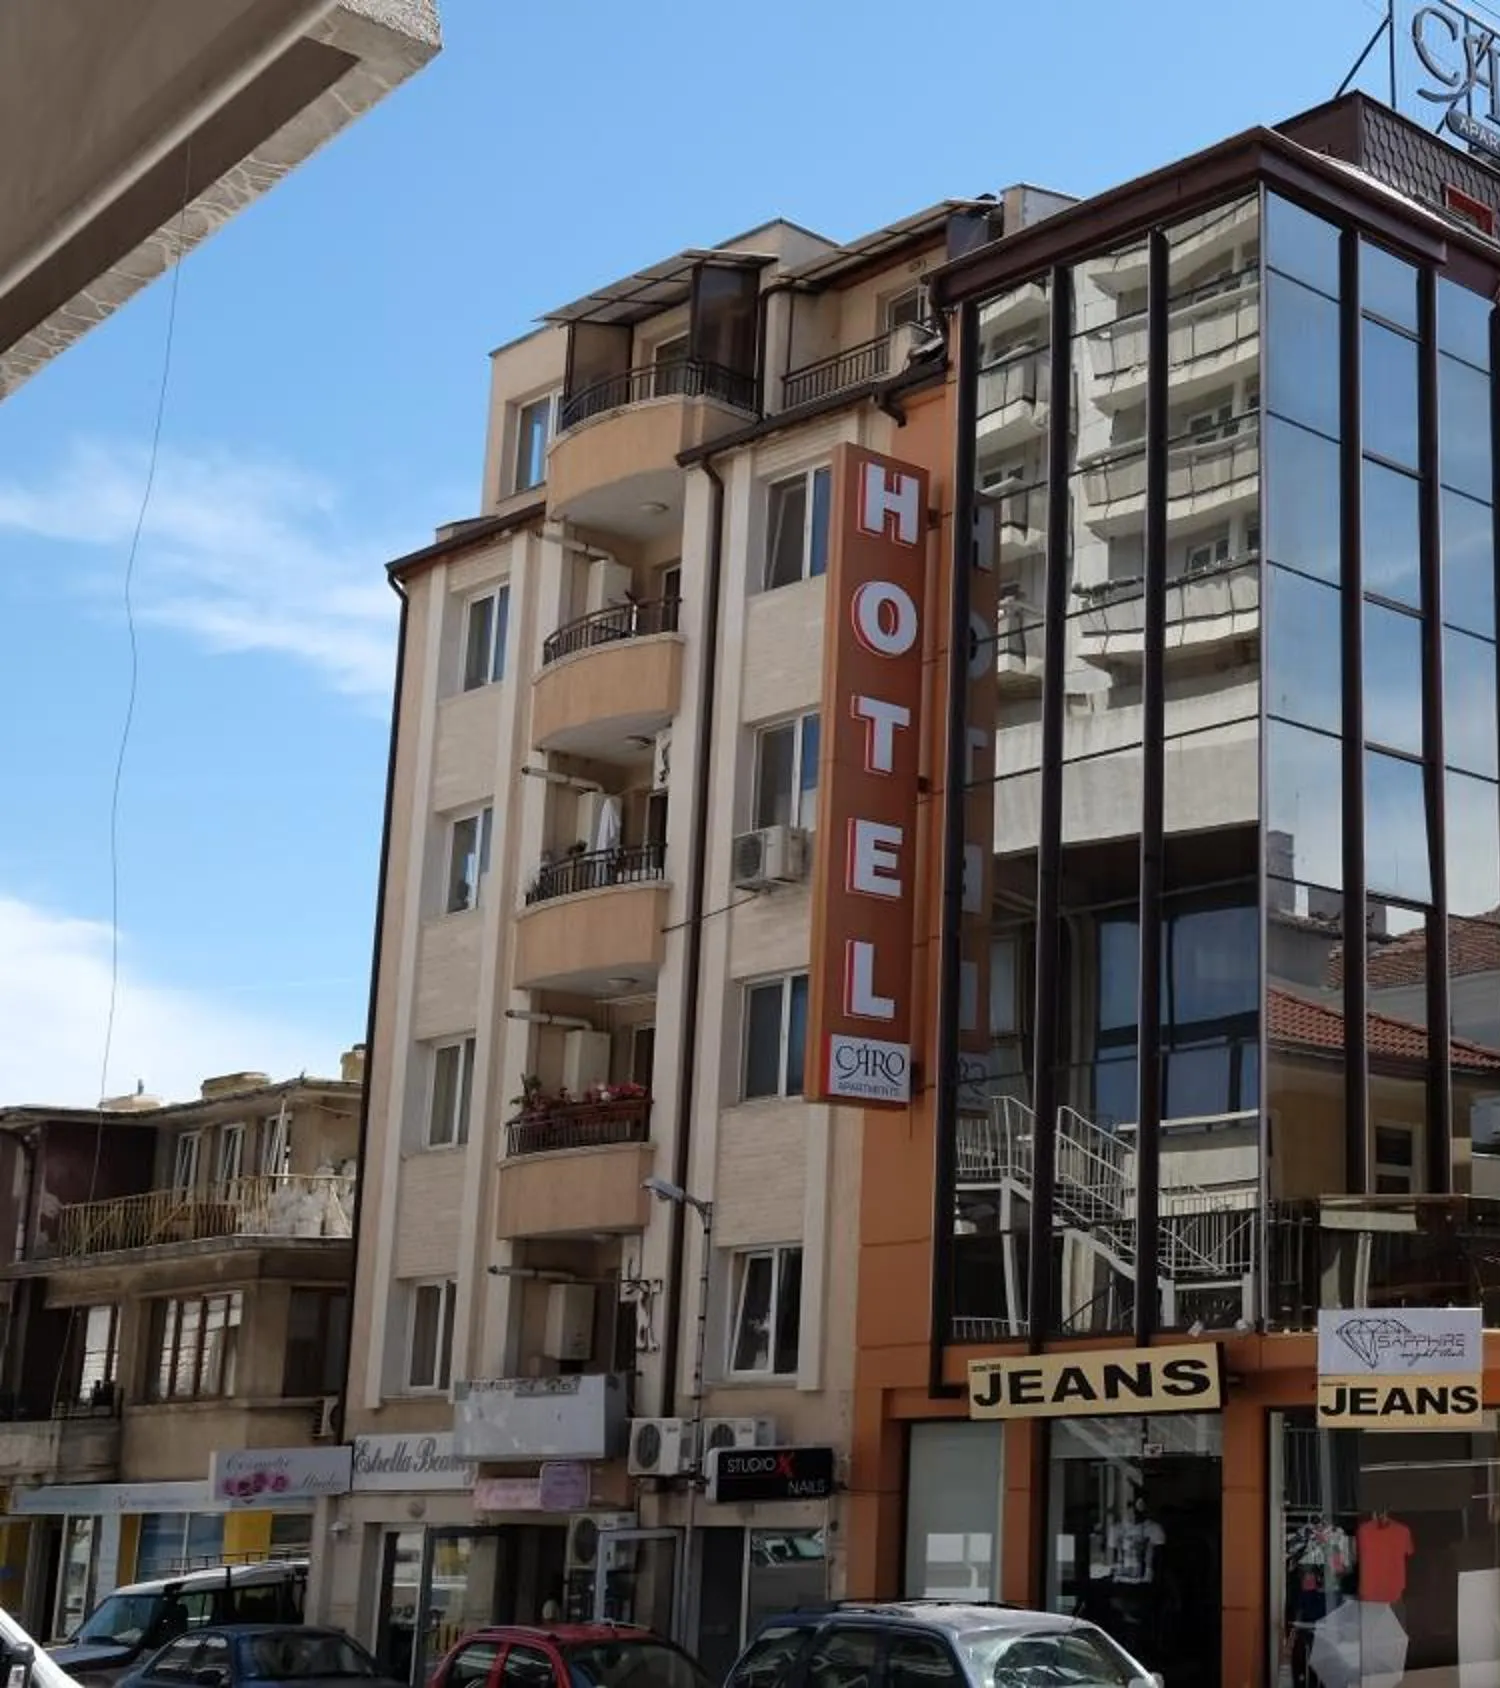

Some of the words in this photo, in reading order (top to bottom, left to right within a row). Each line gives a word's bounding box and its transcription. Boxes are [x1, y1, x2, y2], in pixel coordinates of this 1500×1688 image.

[844, 461, 919, 1021] HOTEL
[1377, 1333, 1465, 1349] SAPPHIRE
[973, 1359, 1211, 1407] JEANS
[1320, 1386, 1479, 1416] JEANS
[727, 1458, 776, 1473] STUDIO
[777, 1453, 795, 1478] X
[788, 1479, 826, 1494] NAILS
